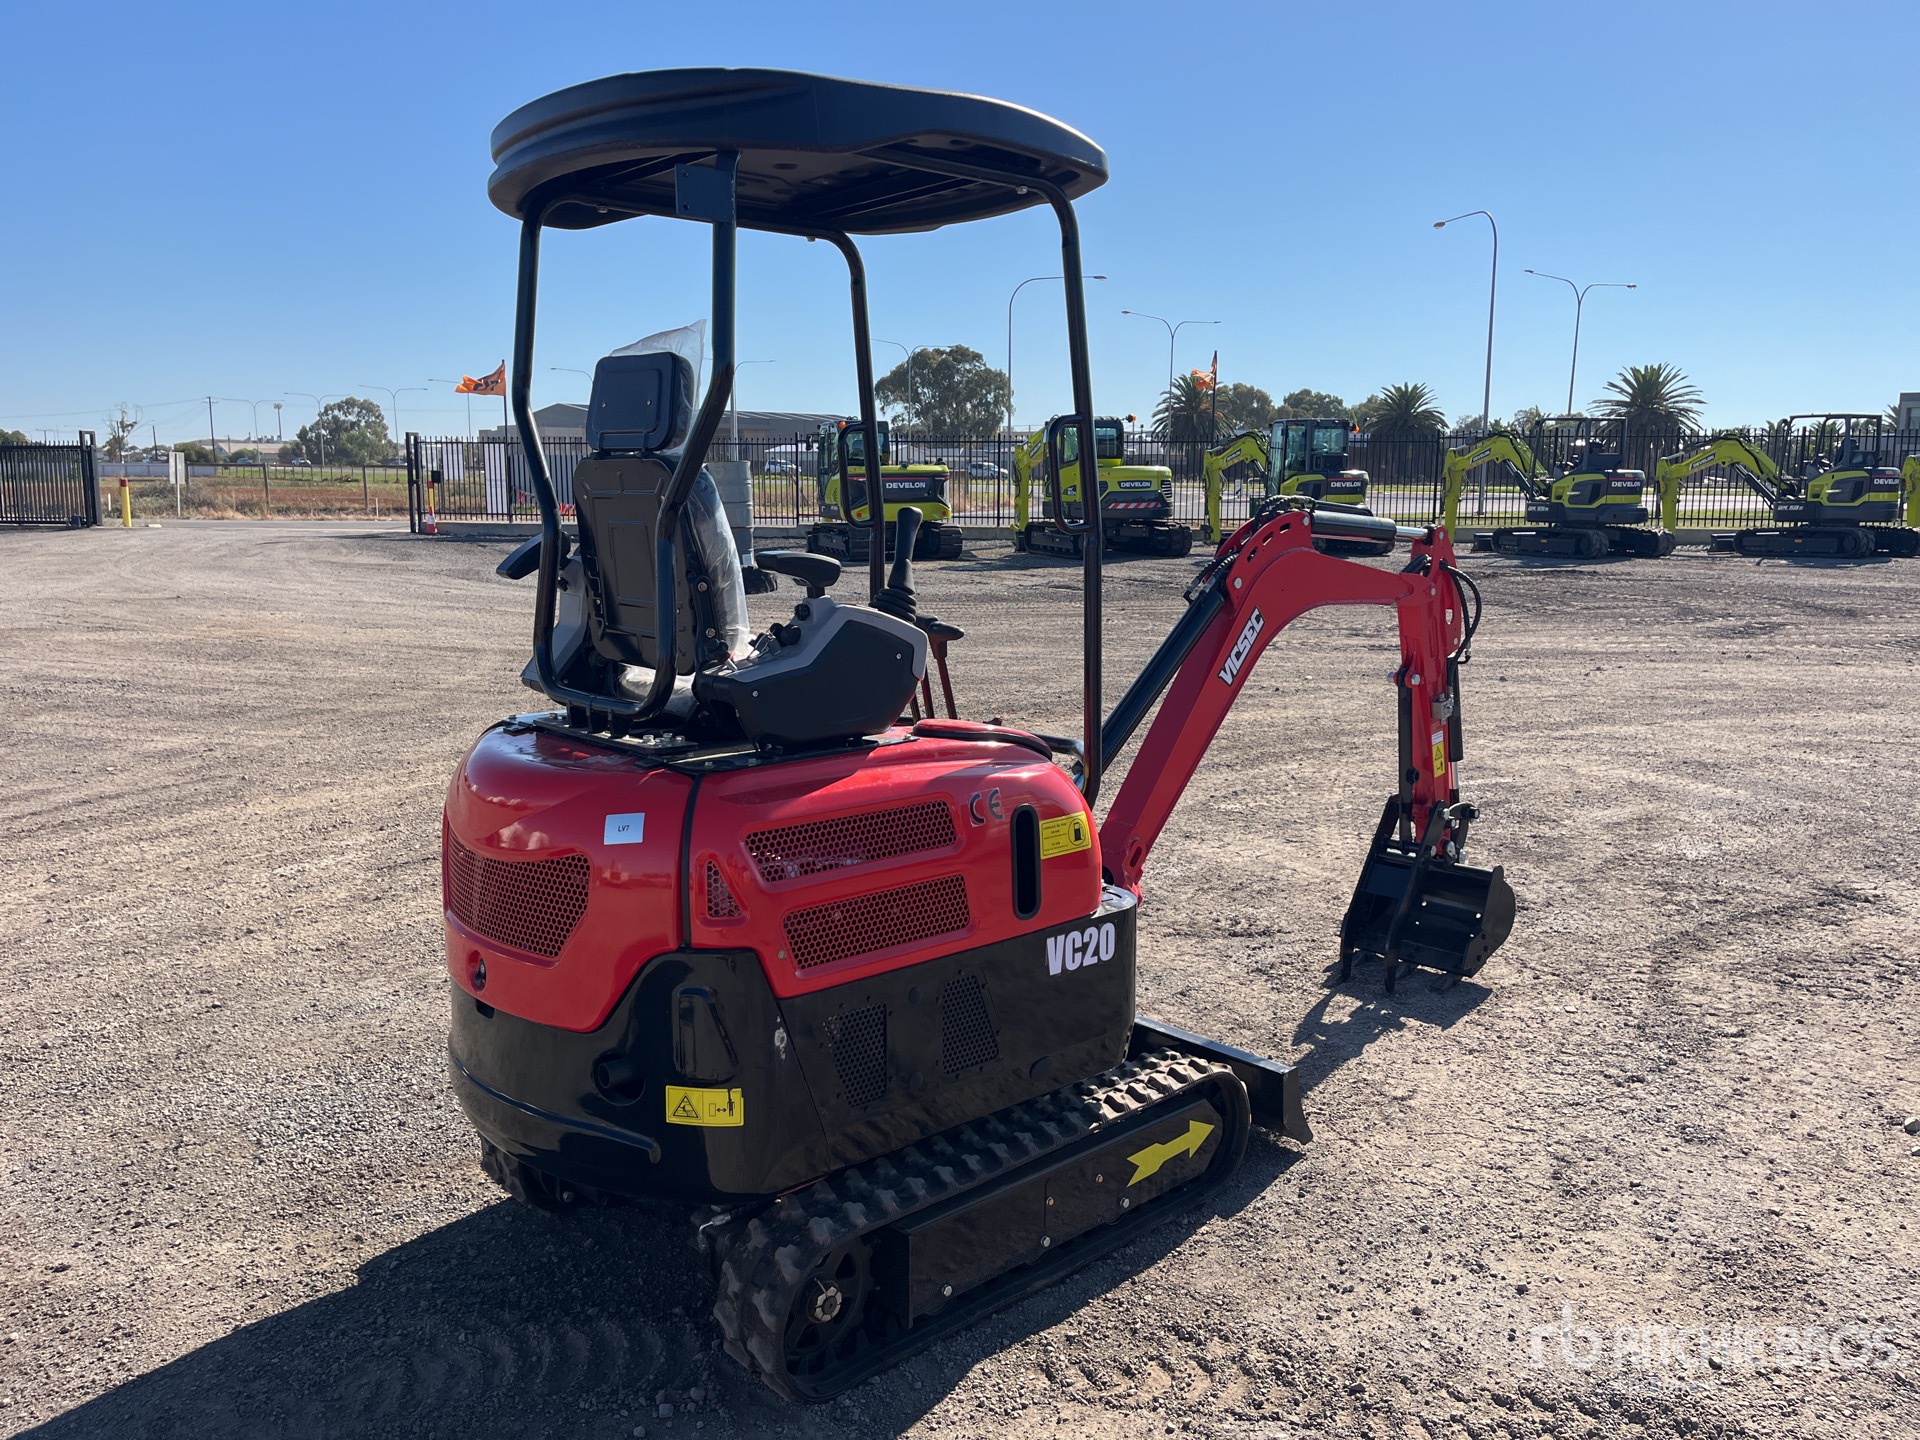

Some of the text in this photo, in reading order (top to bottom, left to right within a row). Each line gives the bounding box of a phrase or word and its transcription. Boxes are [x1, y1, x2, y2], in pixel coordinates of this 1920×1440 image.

[1218, 606, 1265, 686] VICSEC
[617, 824, 630, 832] LV7
[969, 788, 1003, 824] CE
[1046, 922, 1116, 976] VC20
